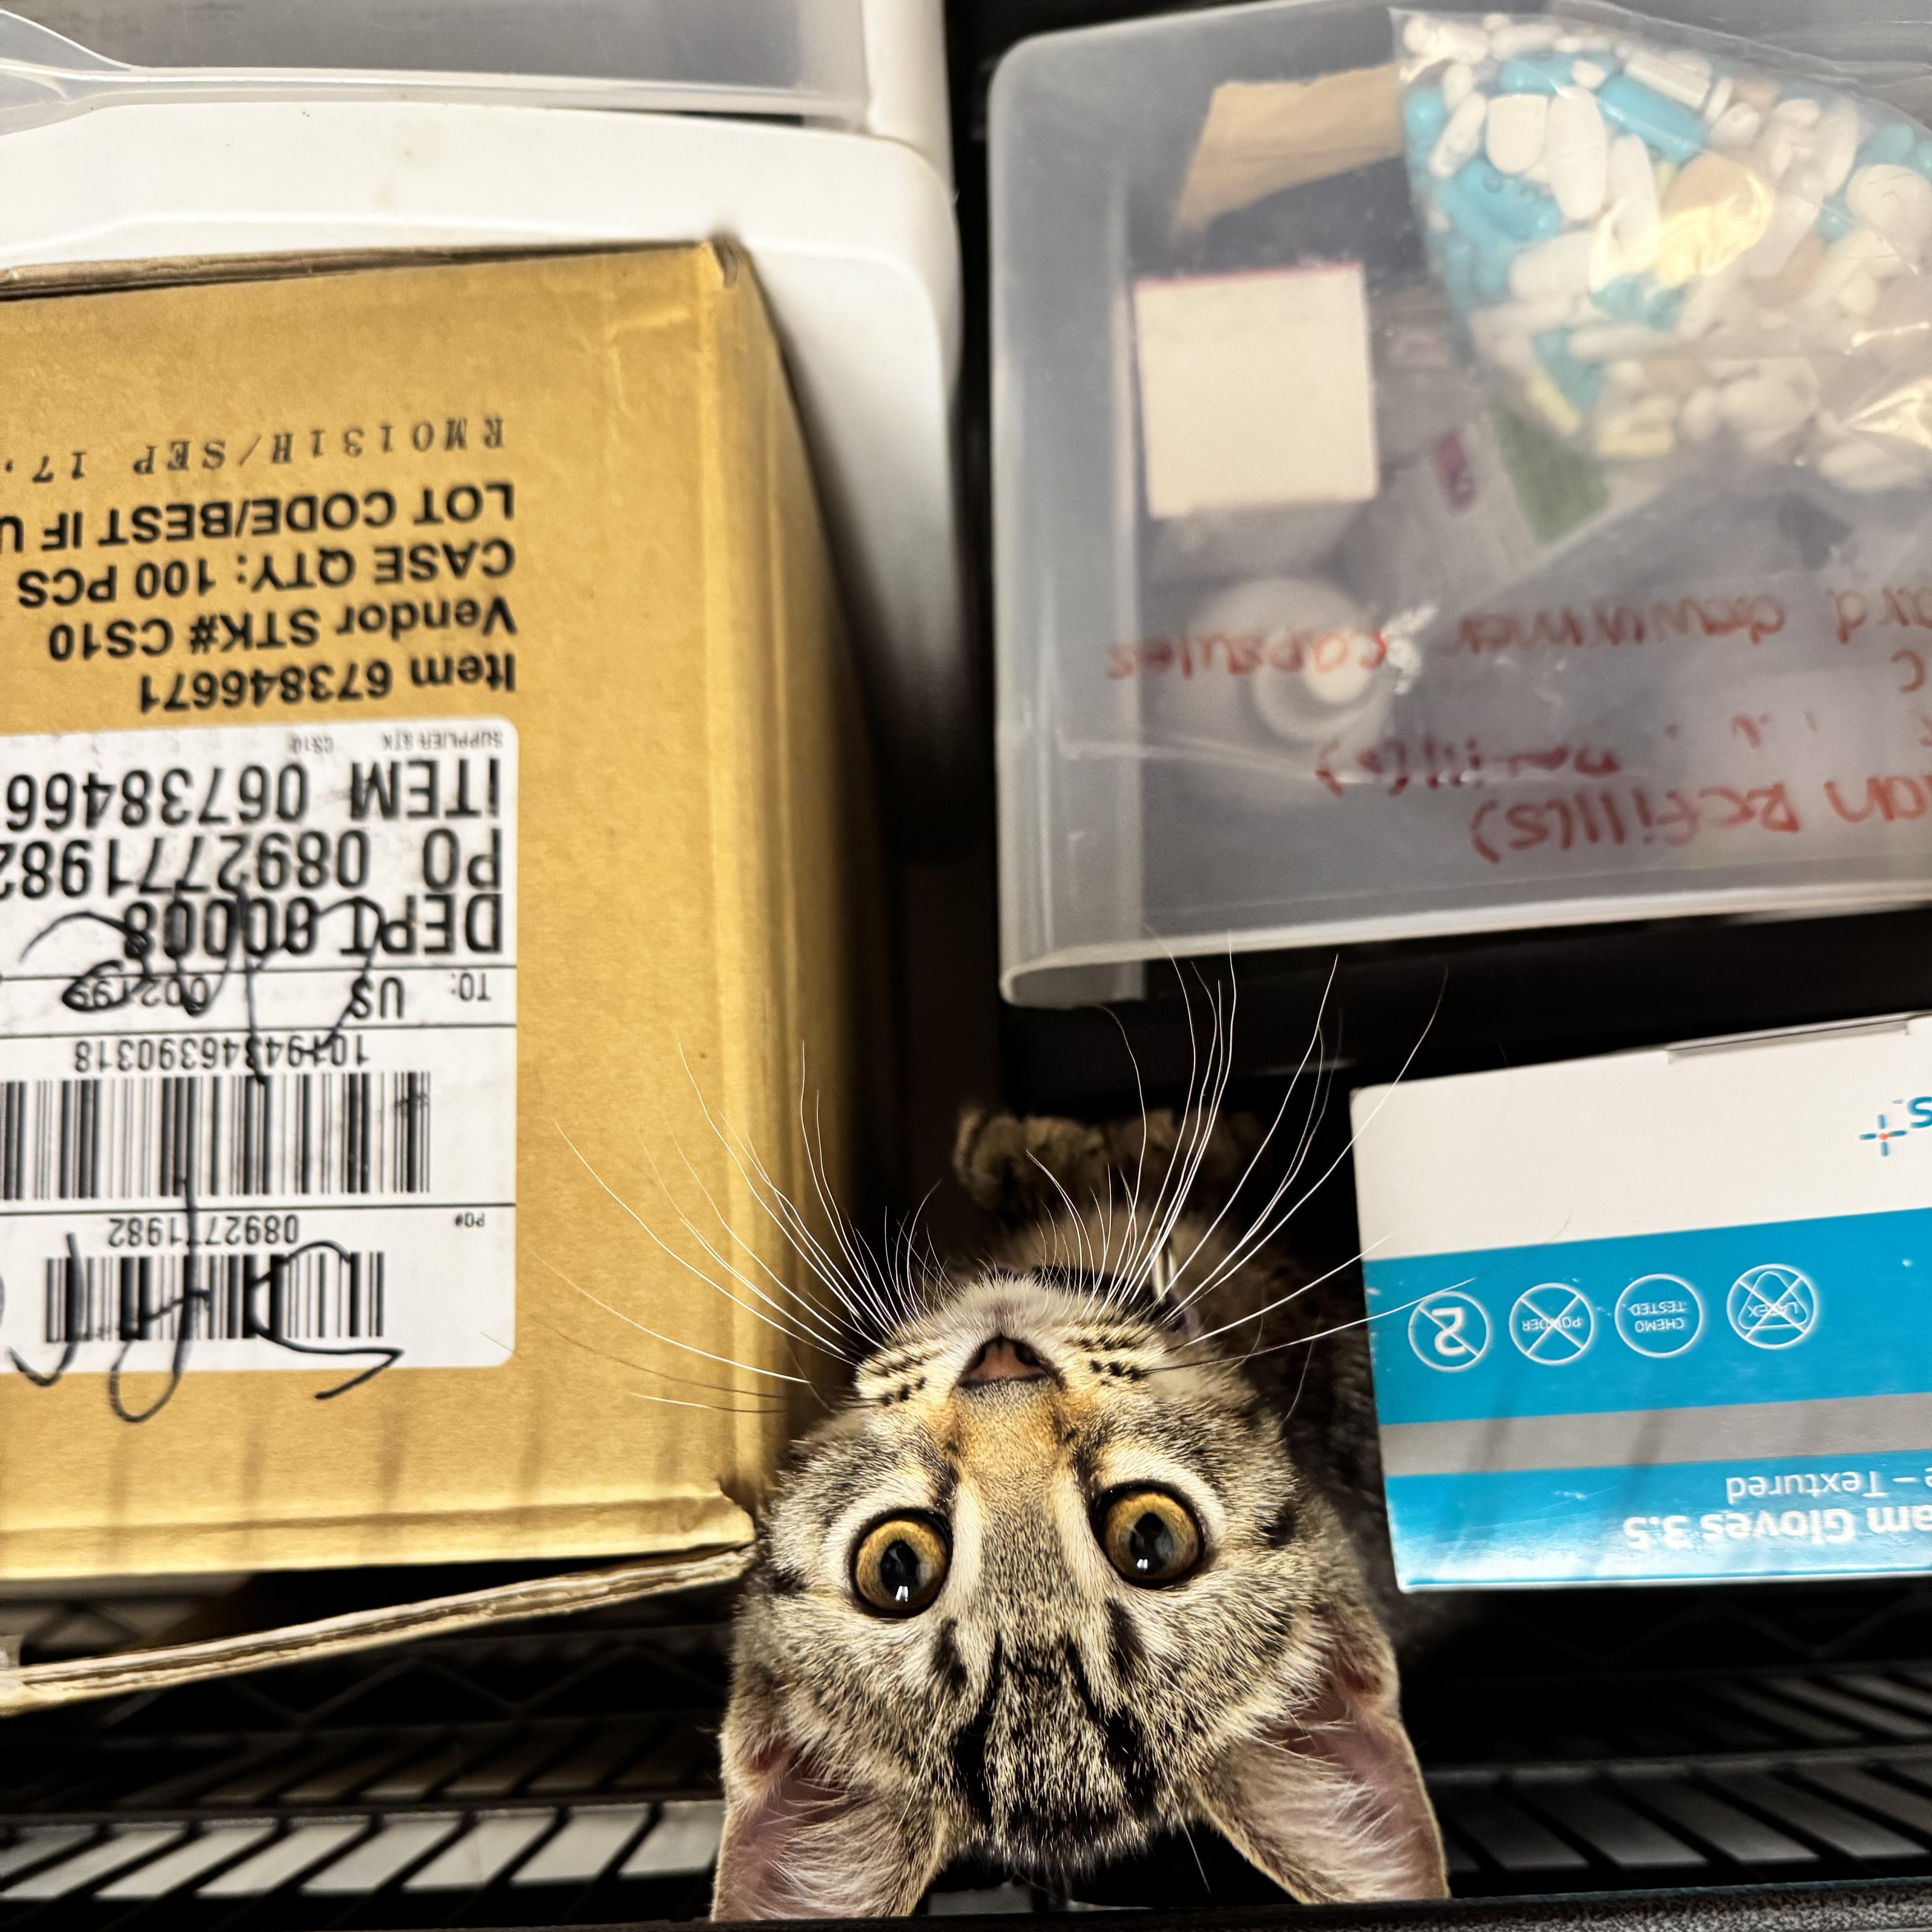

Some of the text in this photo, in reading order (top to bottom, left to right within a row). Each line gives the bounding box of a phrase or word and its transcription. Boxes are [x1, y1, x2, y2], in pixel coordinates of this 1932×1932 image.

[98, 490, 397, 547] CODE/BEST
[414, 482, 515, 526] LOT
[41, 511, 83, 552] IF
[17, 538, 515, 609] CASE QTY: 100 PCS
[48, 596, 517, 662] Vendor STK# CS10
[140, 653, 517, 713] Item 673846671
[6, 757, 502, 833] ITEM 06738466
[421, 828, 503, 892] PO
[123, 892, 503, 962] DEPT 00008
[350, 977, 405, 1020] US
[451, 972, 491, 1002] TO:
[1628, 1301, 1686, 1316] TESTED
[1634, 1317, 1684, 1333] CHEMO
[1726, 1470, 1888, 1504] Textured
[1623, 1515, 1692, 1550] 3.5
[1700, 1508, 1855, 1546] Gloves
